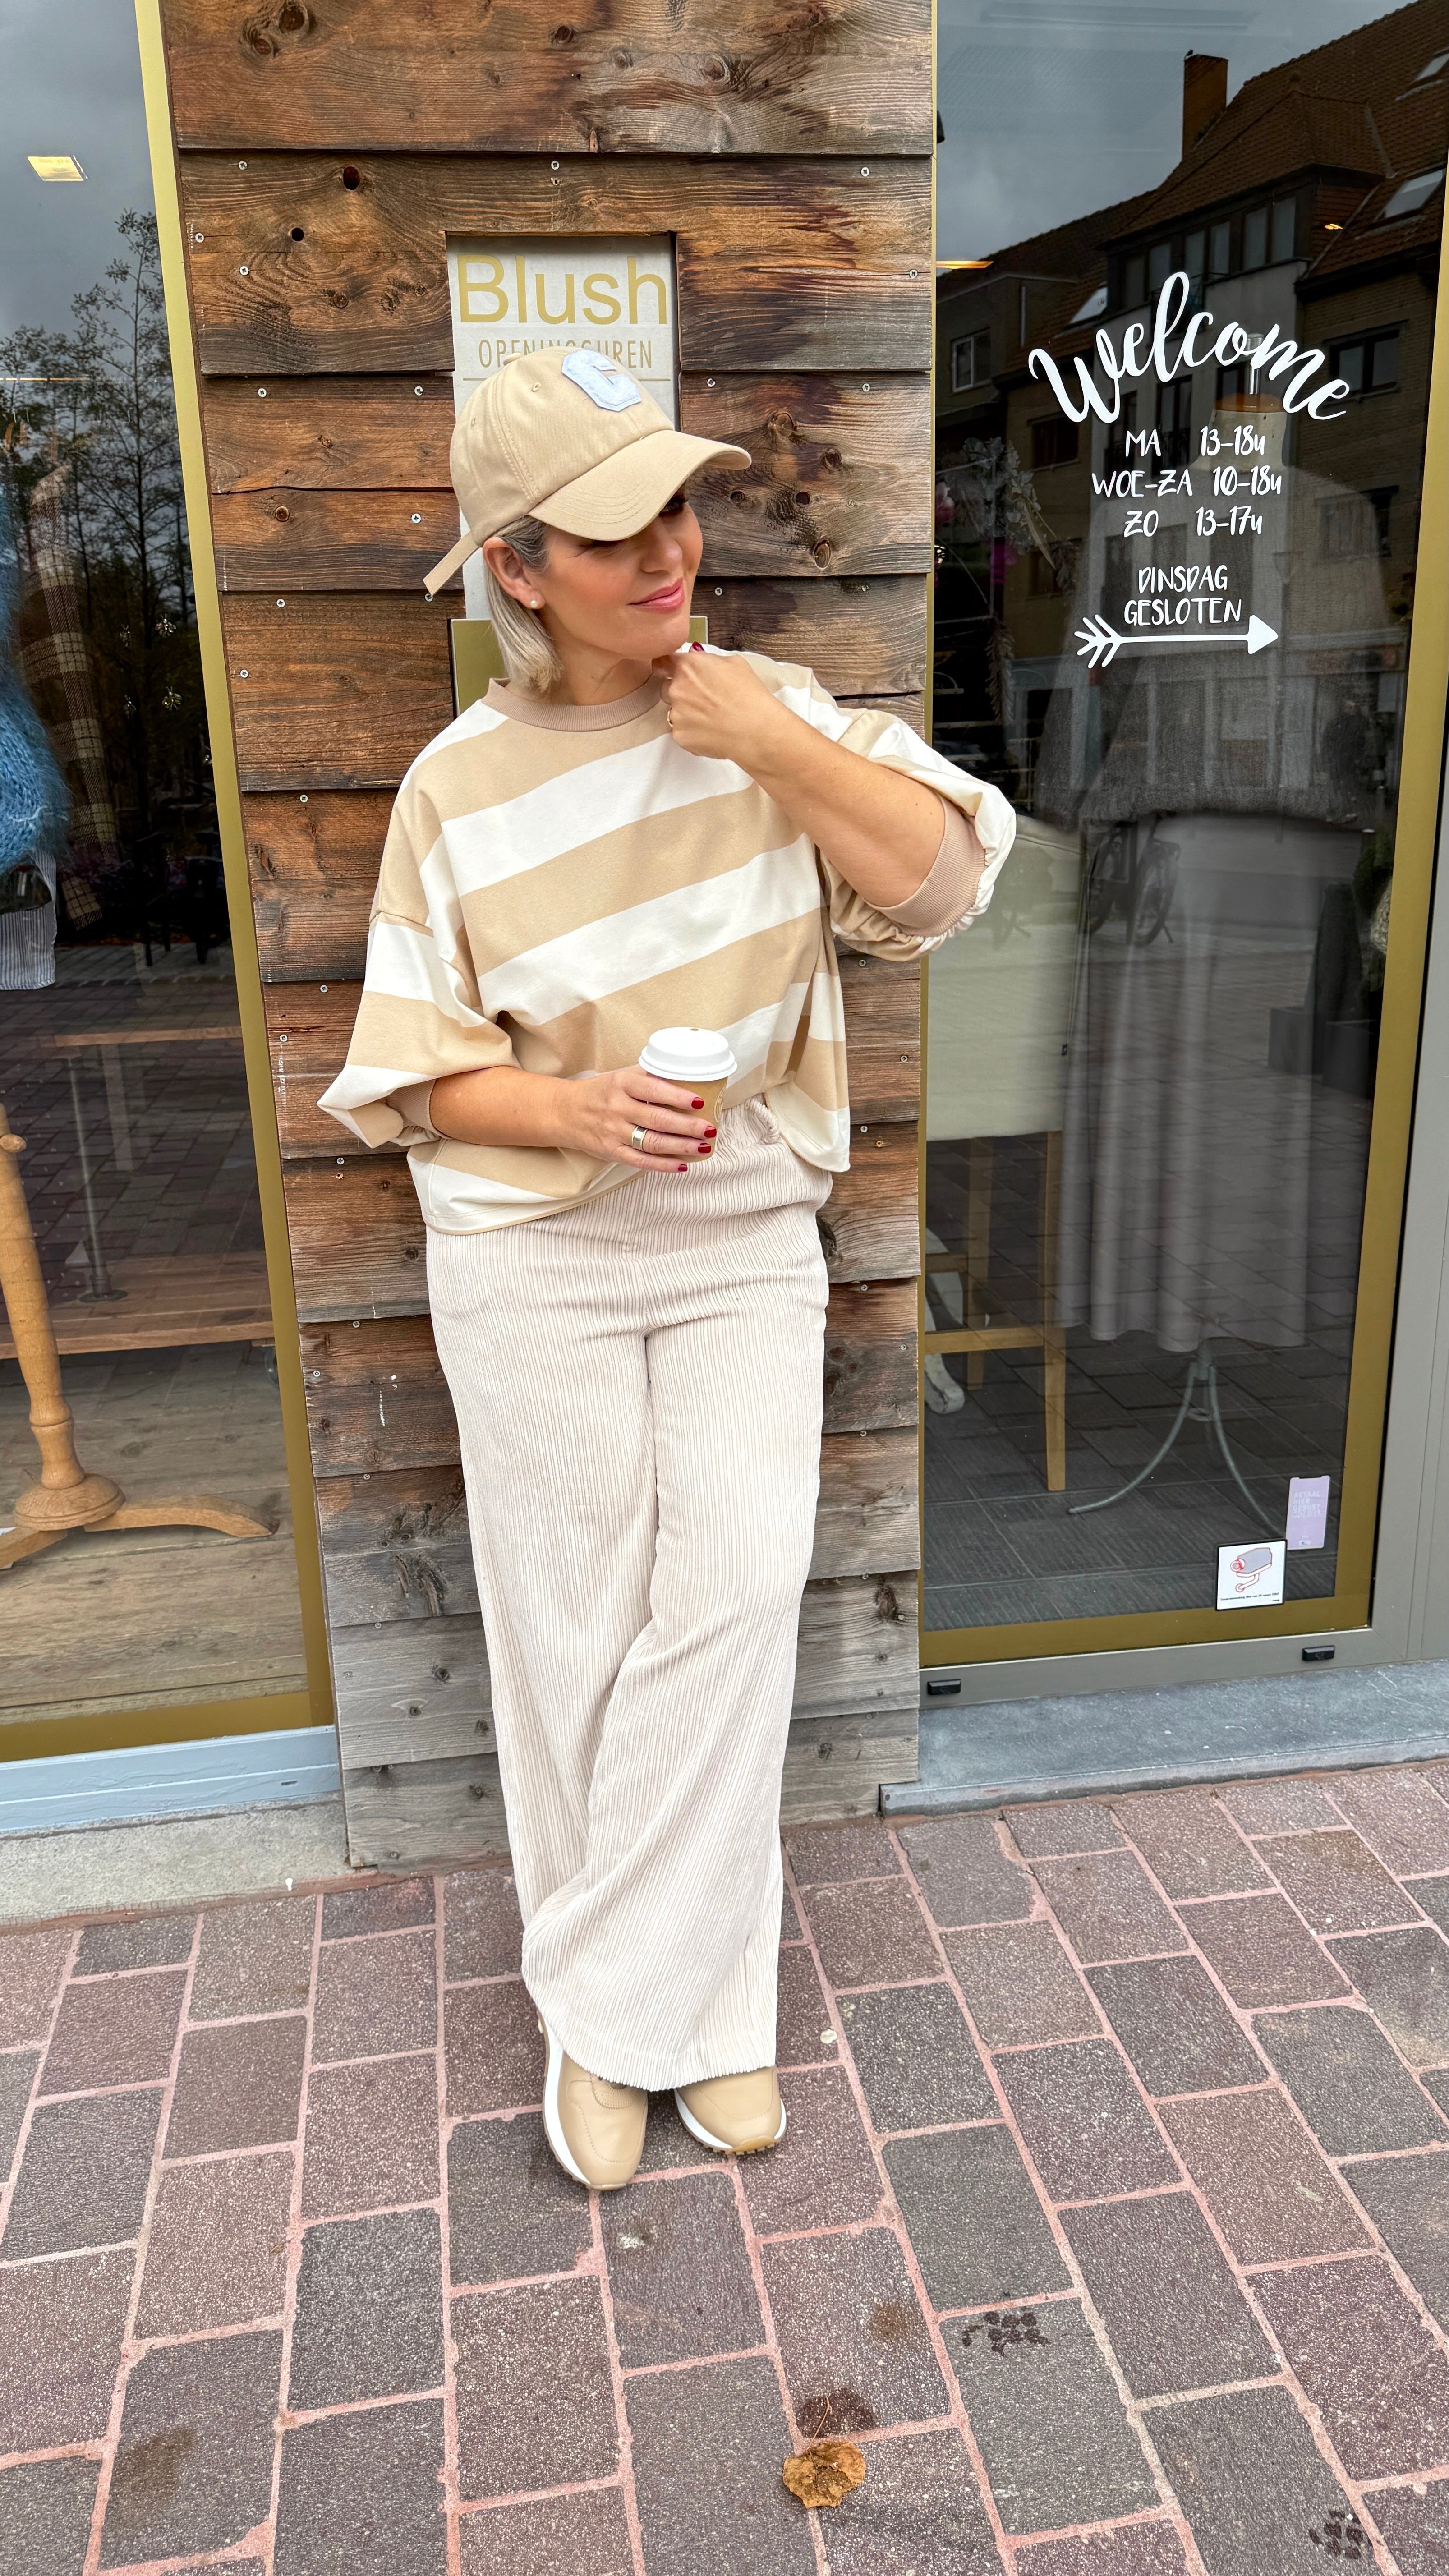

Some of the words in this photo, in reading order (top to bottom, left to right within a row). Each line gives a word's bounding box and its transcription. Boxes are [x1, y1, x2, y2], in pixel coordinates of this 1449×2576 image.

[457, 253, 667, 325] Blush
[1028, 271, 1350, 423] Welcome
[1125, 429, 1161, 457] MA
[1200, 425, 1265, 457] 13-18u
[1092, 469, 1193, 498] WOE-ZA
[1213, 465, 1282, 497] 10-18u
[1124, 510, 1159, 538] ZO
[1196, 505, 1263, 537] 13-17u
[1139, 565, 1228, 593] DINSDAG
[1124, 597, 1242, 626] GESLOTEN
